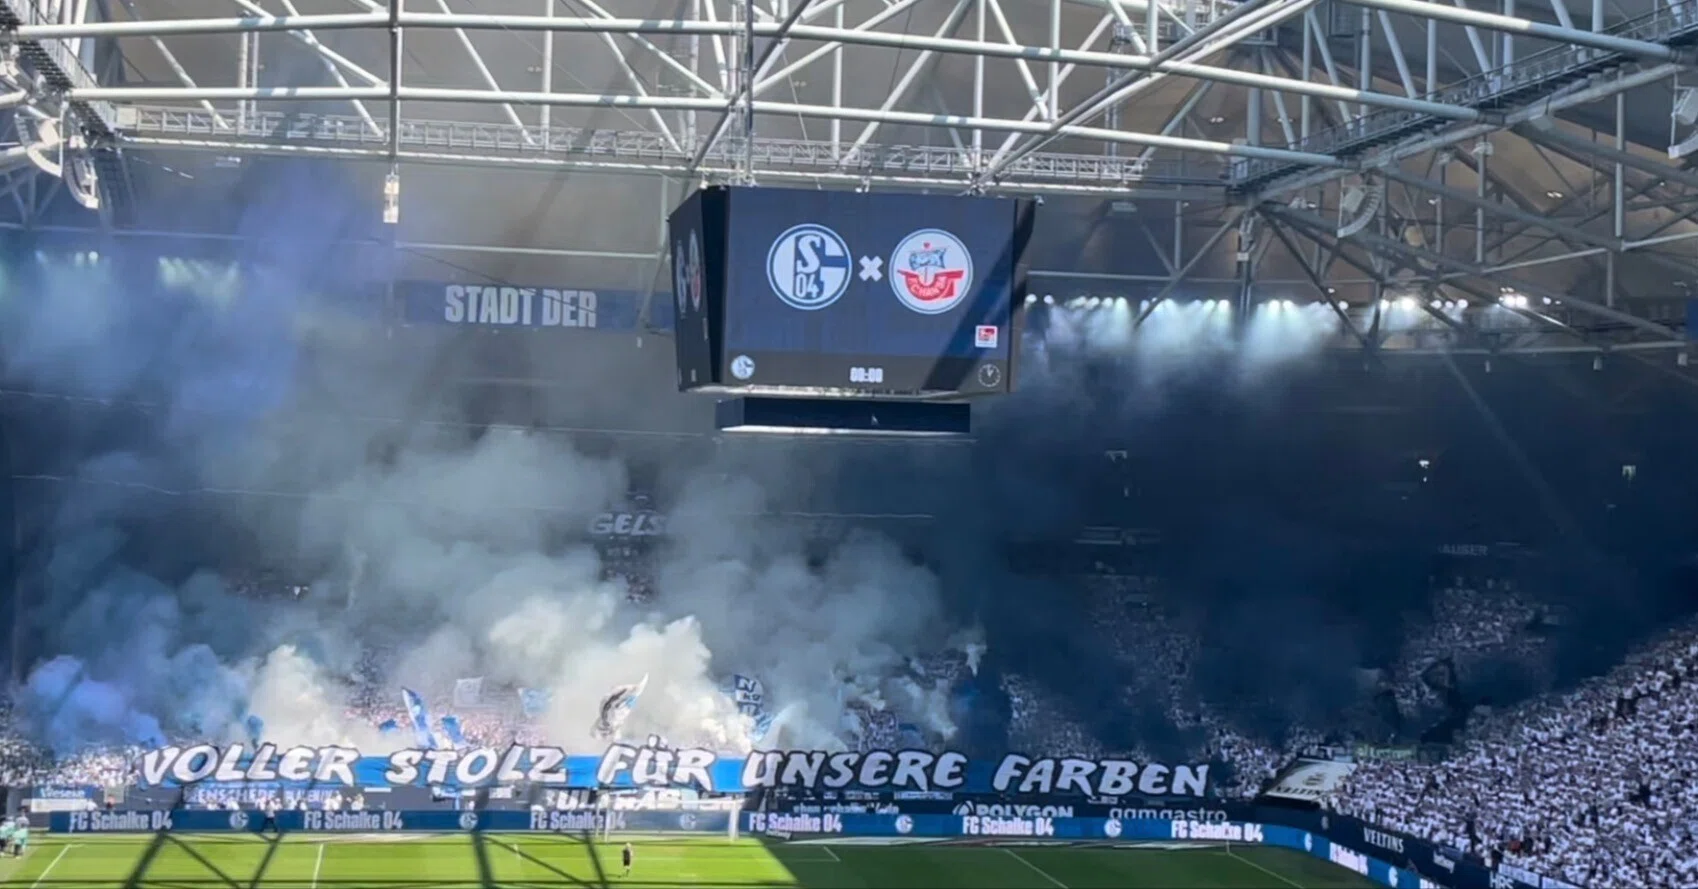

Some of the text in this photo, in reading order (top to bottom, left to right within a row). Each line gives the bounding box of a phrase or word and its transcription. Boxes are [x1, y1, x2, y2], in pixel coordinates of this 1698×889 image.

[444, 284, 597, 328] STADT DER
[142, 734, 1210, 798] VOLLER STOLZ FÜR UNSERE FARBEN
[70, 811, 174, 830] FC Schalke 04
[303, 811, 404, 830] FC Schalke 04
[976, 804, 1073, 818] POLYGON
[748, 813, 842, 833] FC Schalke 04
[962, 816, 1055, 837] FC Schalke 04
[1171, 820, 1264, 842] FC Schalke 04
[1363, 828, 1404, 854] VELTINS
